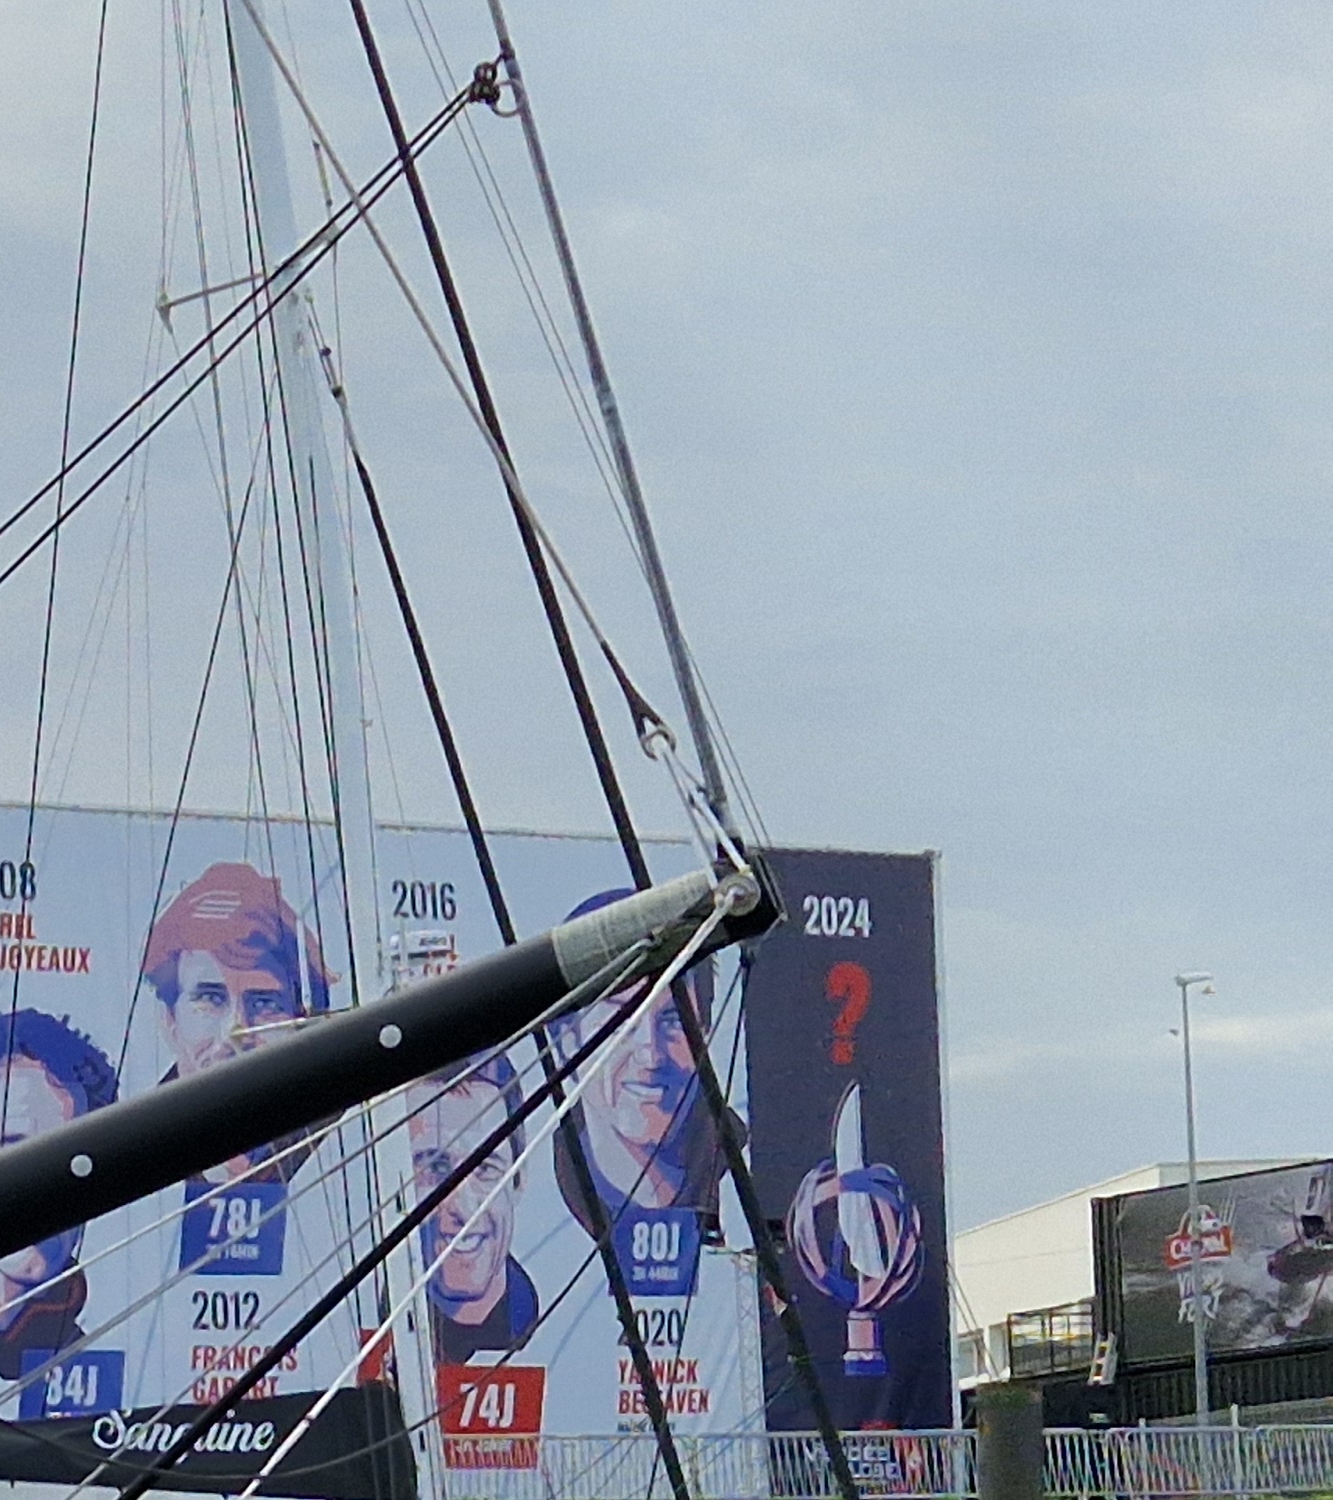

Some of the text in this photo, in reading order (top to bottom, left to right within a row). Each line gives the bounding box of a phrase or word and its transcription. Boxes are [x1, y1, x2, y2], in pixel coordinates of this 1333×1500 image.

[392, 880, 456, 920] 2016
[803, 895, 873, 938] 2024
[826, 961, 872, 1065] ?
[209, 1197, 261, 1239] 78J
[633, 1221, 682, 1262] 80J
[192, 1290, 261, 1330] 2012
[45, 1366, 98, 1407] 84J
[619, 1359, 698, 1384] YANICK
[459, 1383, 515, 1428] 74J
[619, 1389, 709, 1414] BEAVEN
[93, 1408, 276, 1465] Sanuine
